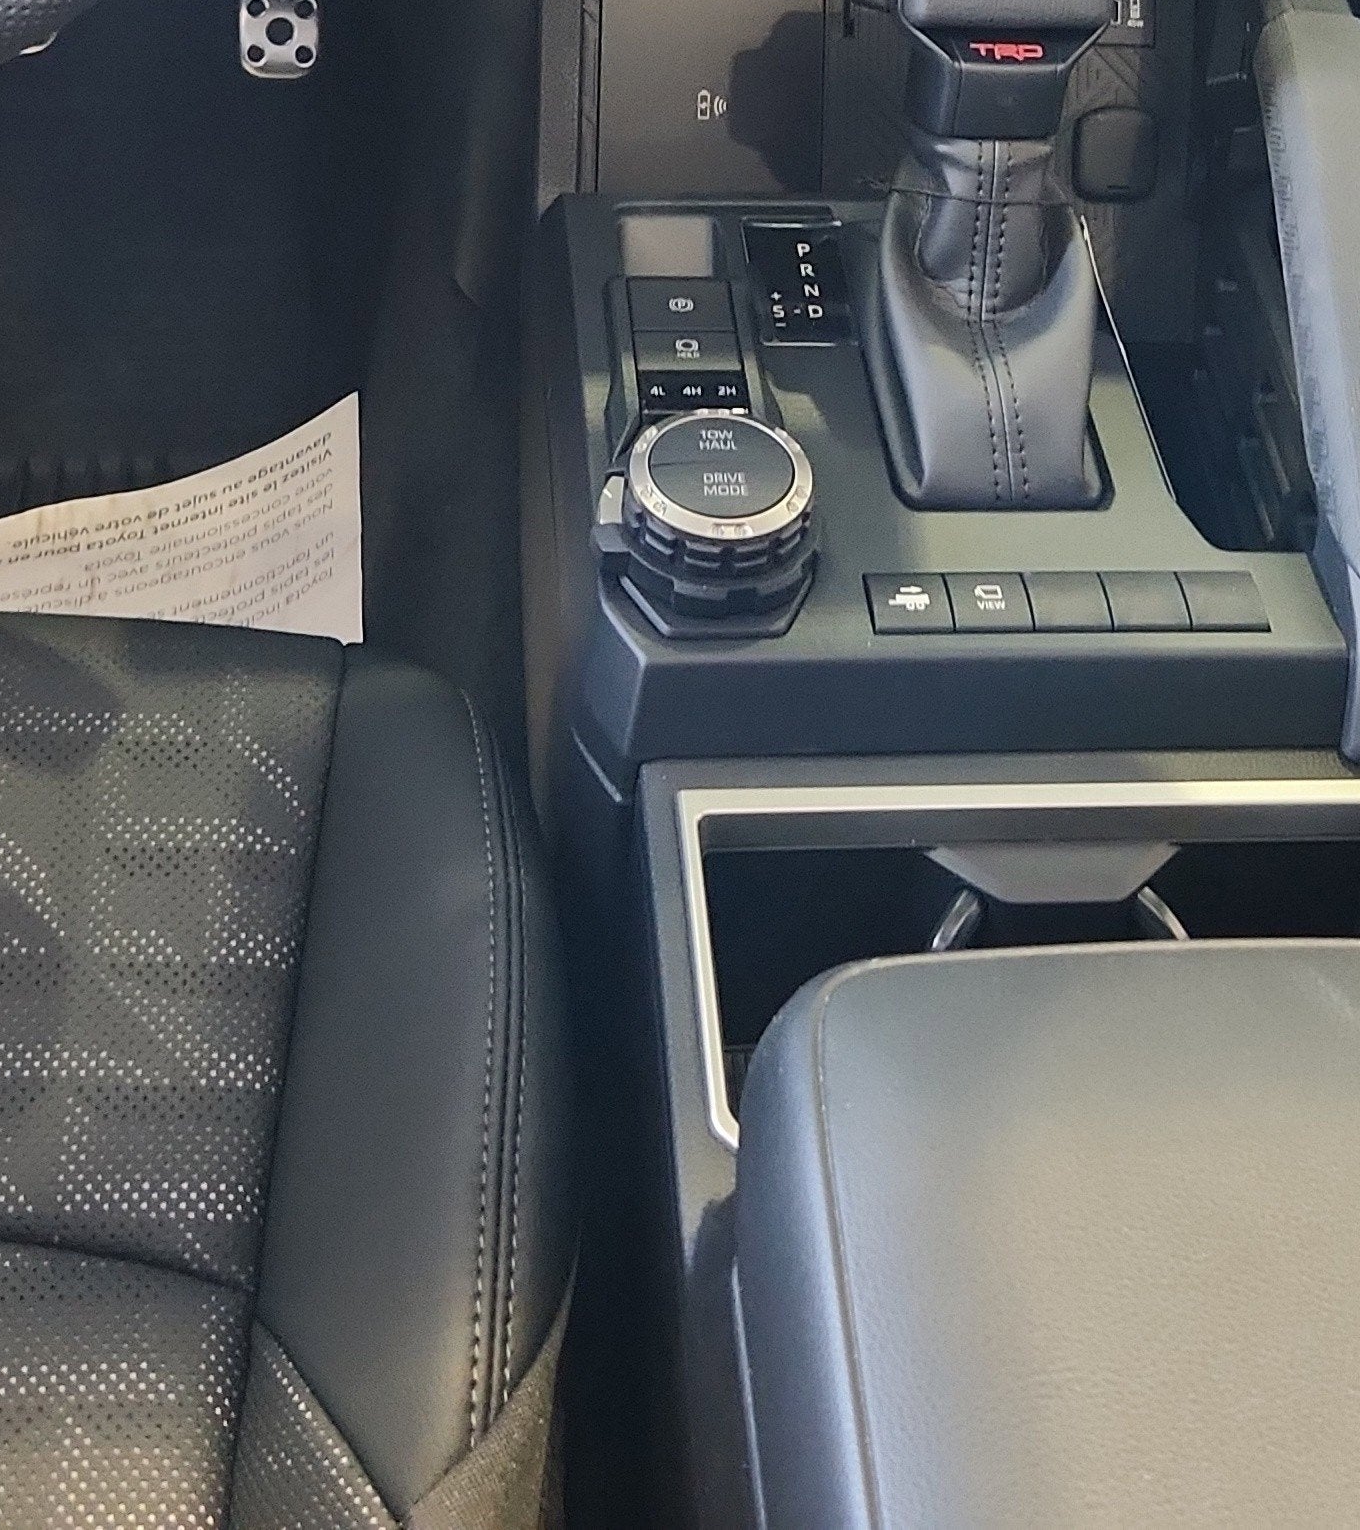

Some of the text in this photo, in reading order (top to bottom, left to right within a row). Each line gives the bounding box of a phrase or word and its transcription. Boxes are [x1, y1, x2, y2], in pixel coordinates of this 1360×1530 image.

[969, 42, 1044, 61] TRD
[796, 242, 811, 258] P
[799, 263, 816, 278] R
[803, 283, 820, 298] N
[772, 304, 823, 319] S D
[650, 385, 666, 397] 4L
[682, 385, 702, 397] 4H
[717, 385, 737, 397] 2H
[699, 439, 738, 451] HAUL
[247, 432, 332, 483] davantage
[281, 449, 333, 484] Visitez
[222, 480, 243, 494] au
[262, 480, 278, 494] le
[295, 468, 334, 497] votre
[702, 471, 747, 484] DRIVE
[228, 489, 258, 508] site
[307, 482, 334, 505] des
[703, 484, 749, 496] MODE
[174, 489, 217, 513] sujet
[94, 514, 142, 530] votre
[147, 506, 170, 520] de
[152, 504, 224, 535] internet
[263, 504, 303, 531] tapis
[294, 498, 334, 529] Nous
[149, 493, 291, 556] concessionnaire
[86, 529, 146, 551] Toyota
[156, 524, 258, 569] protecteurs
[251, 529, 290, 552] vous
[315, 531, 335, 550] un
[8, 553, 30, 565] en
[32, 543, 81, 559] pour
[106, 564, 148, 582] avec
[114, 550, 246, 597] encourageons
[270, 549, 335, 594] les tapis
[172, 549, 311, 615] fonctionnement
[285, 567, 334, 607] Toyota
[976, 600, 1006, 611] VIEW
